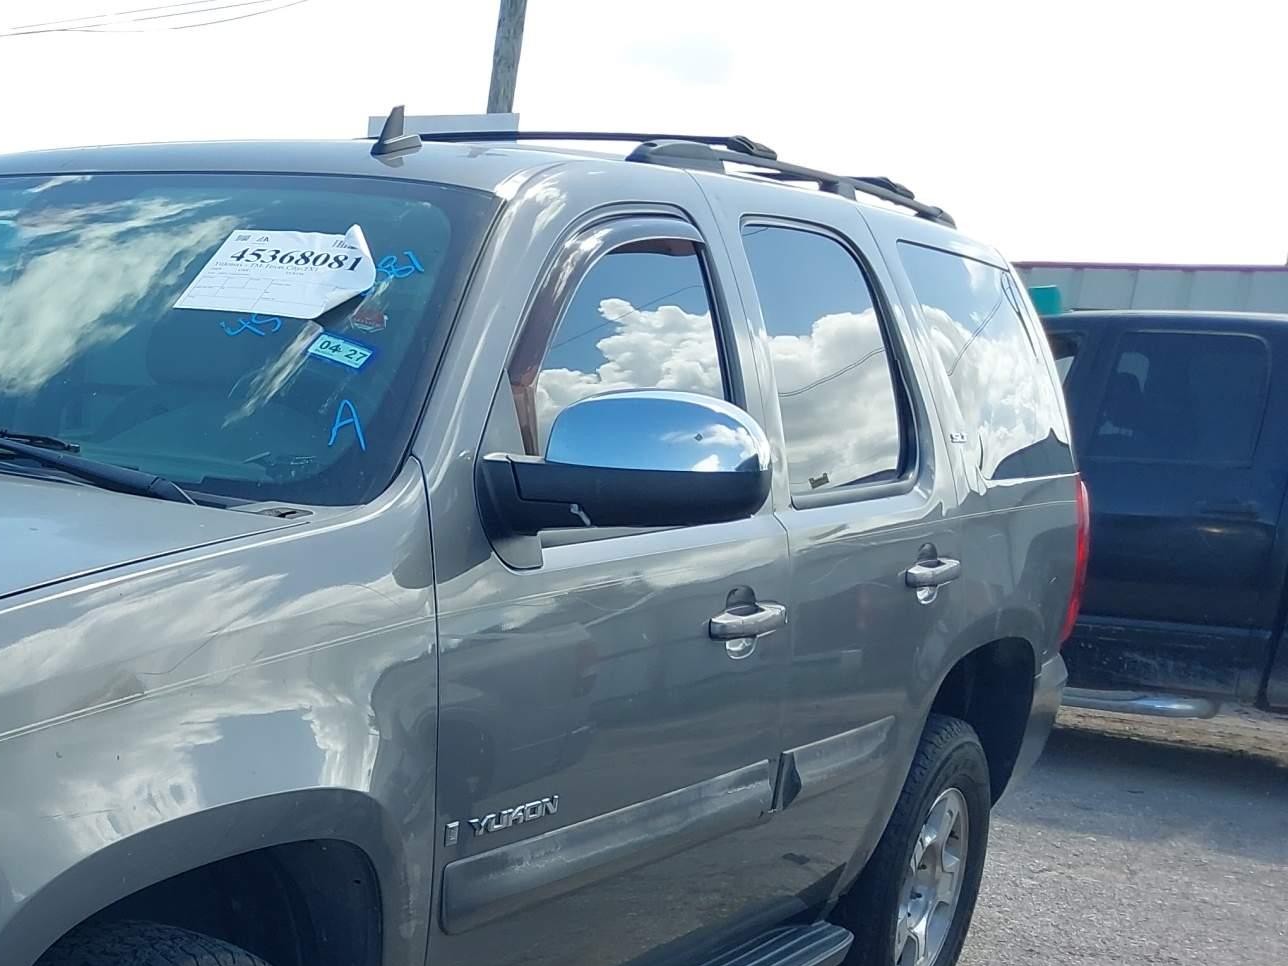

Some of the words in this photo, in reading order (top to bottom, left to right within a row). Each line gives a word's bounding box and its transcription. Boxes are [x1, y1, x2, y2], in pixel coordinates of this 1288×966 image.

[230, 247, 363, 272] 45368081
[319, 340, 341, 354] 04
[344, 349, 369, 362] 27
[327, 399, 366, 451] A
[468, 795, 559, 837] YUKON
